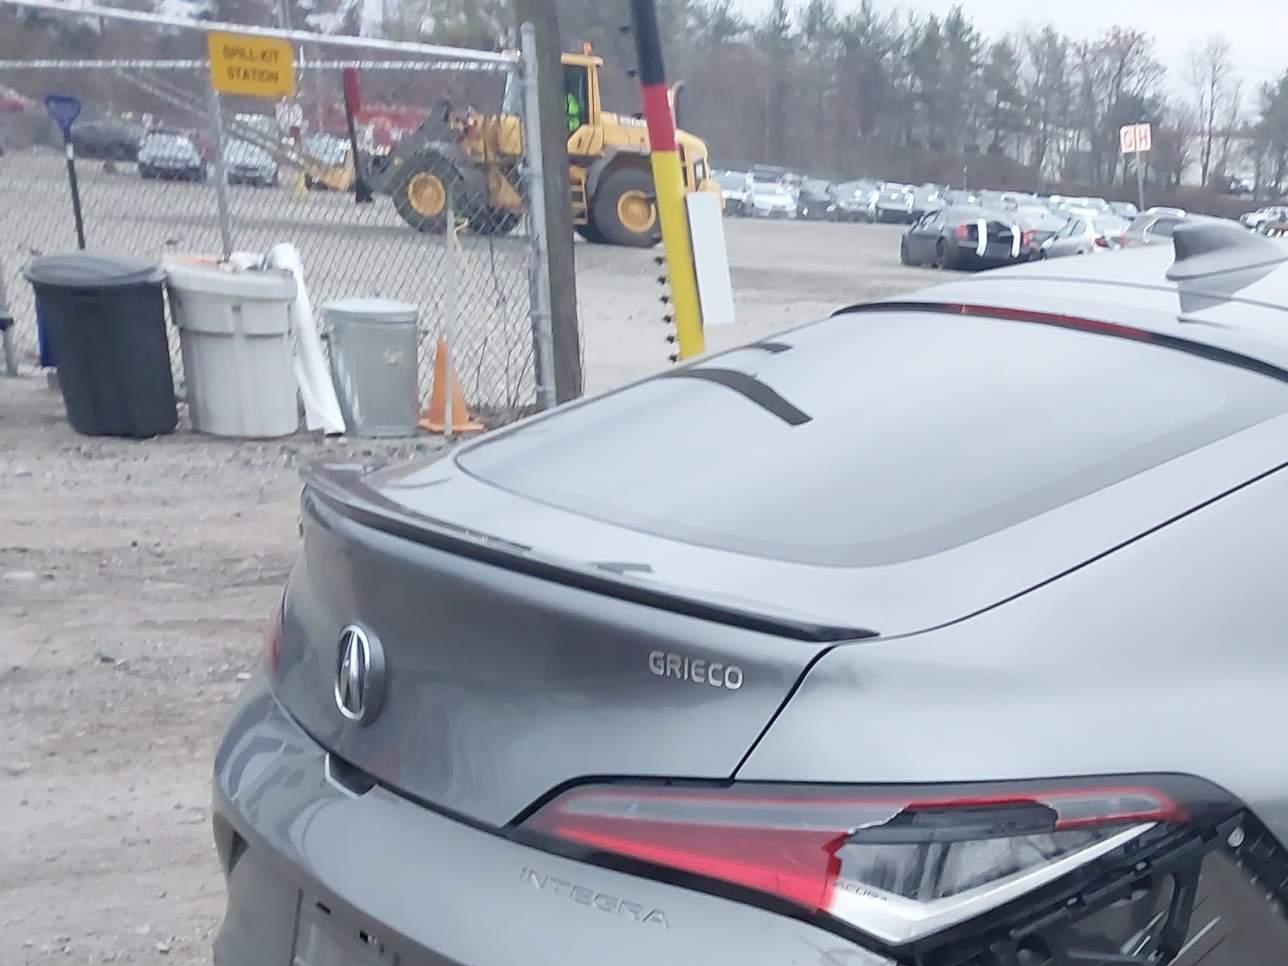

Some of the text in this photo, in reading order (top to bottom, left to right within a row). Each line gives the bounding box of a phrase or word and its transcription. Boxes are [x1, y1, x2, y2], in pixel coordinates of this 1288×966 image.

[226, 66, 279, 82] STATION
[648, 650, 743, 690] GRIECO
[519, 866, 670, 929] INTEGRA
